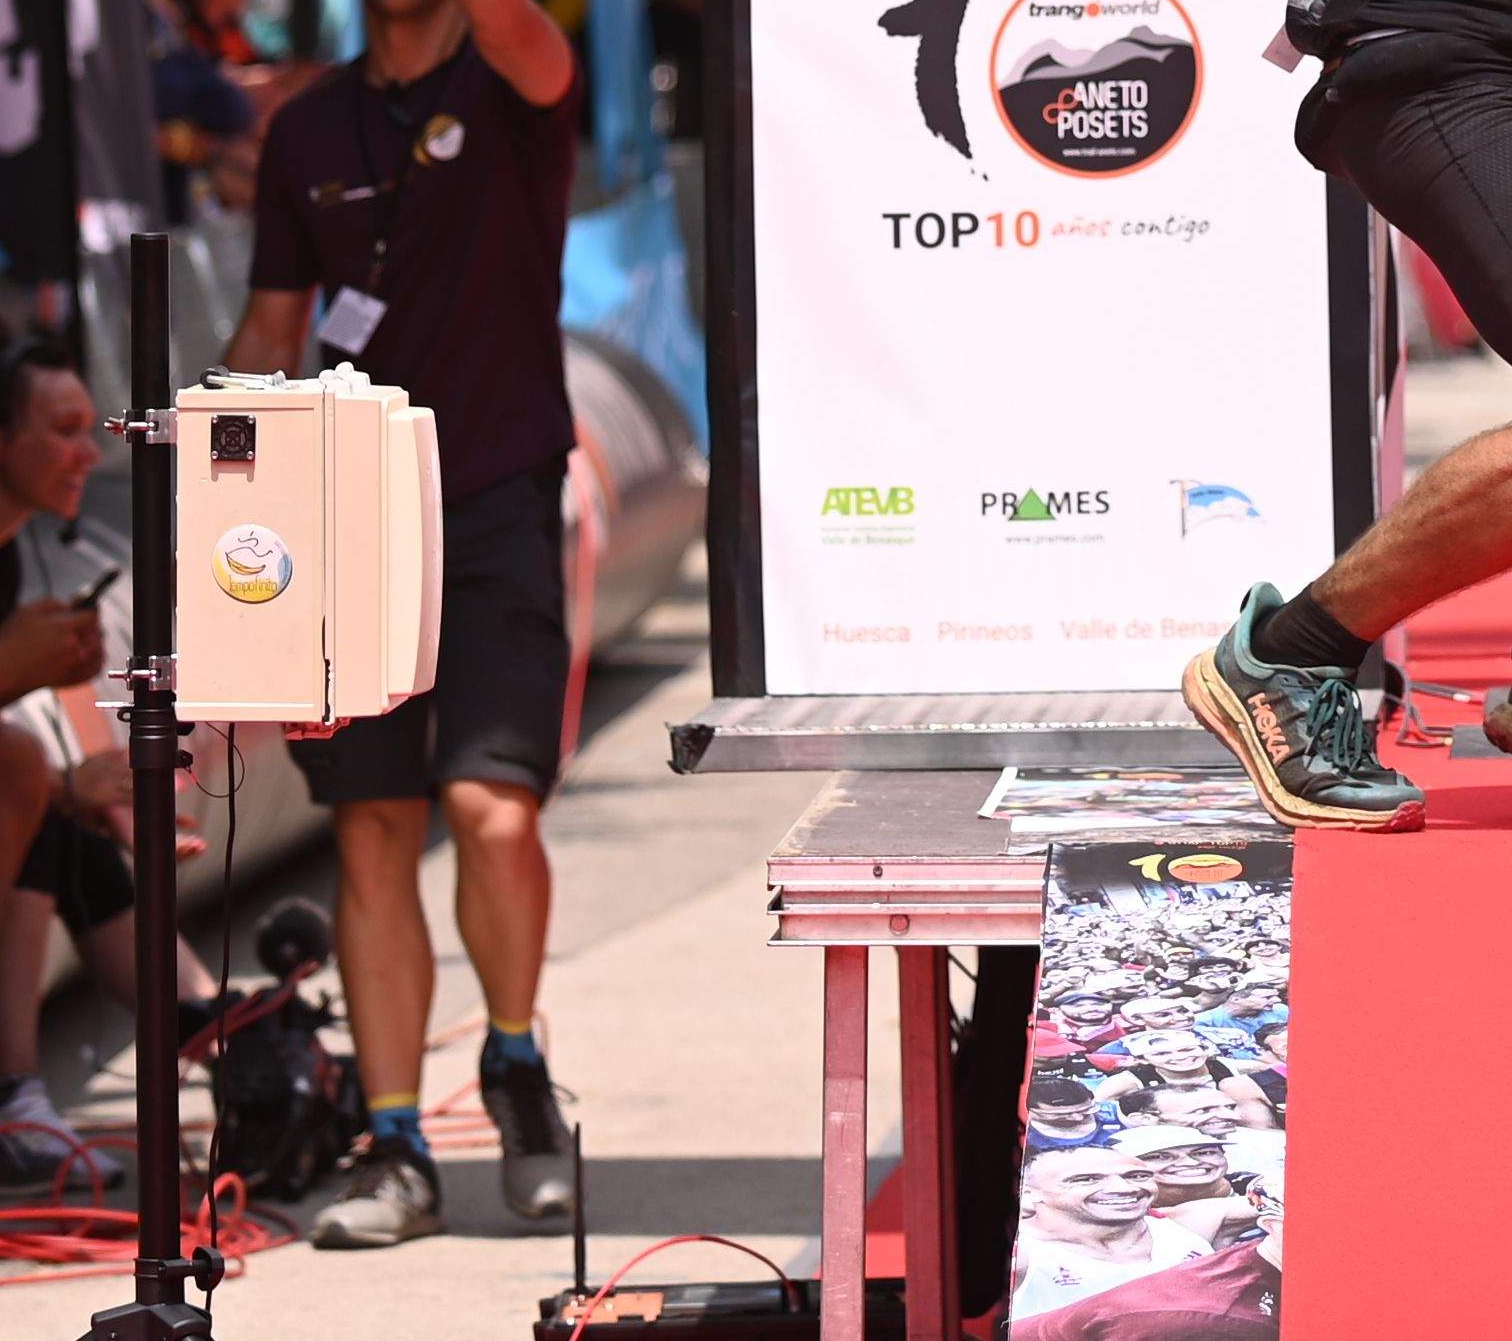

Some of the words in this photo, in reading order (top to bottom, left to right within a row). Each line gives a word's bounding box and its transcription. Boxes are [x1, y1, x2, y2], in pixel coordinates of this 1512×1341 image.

[1073, 80, 1149, 110] ANETO
[1057, 109, 1150, 140] POSETS
[1051, 214, 1112, 238] años
[1120, 215, 1211, 242] contigo
[981, 488, 1110, 521] PRAMES
[823, 621, 911, 645] Huesca
[937, 620, 1034, 643] Pirineos
[1061, 618, 1118, 641] Valle
[1124, 618, 1153, 640] de
[1161, 618, 1232, 640] Benas
[1247, 692, 1290, 765] HOKA
